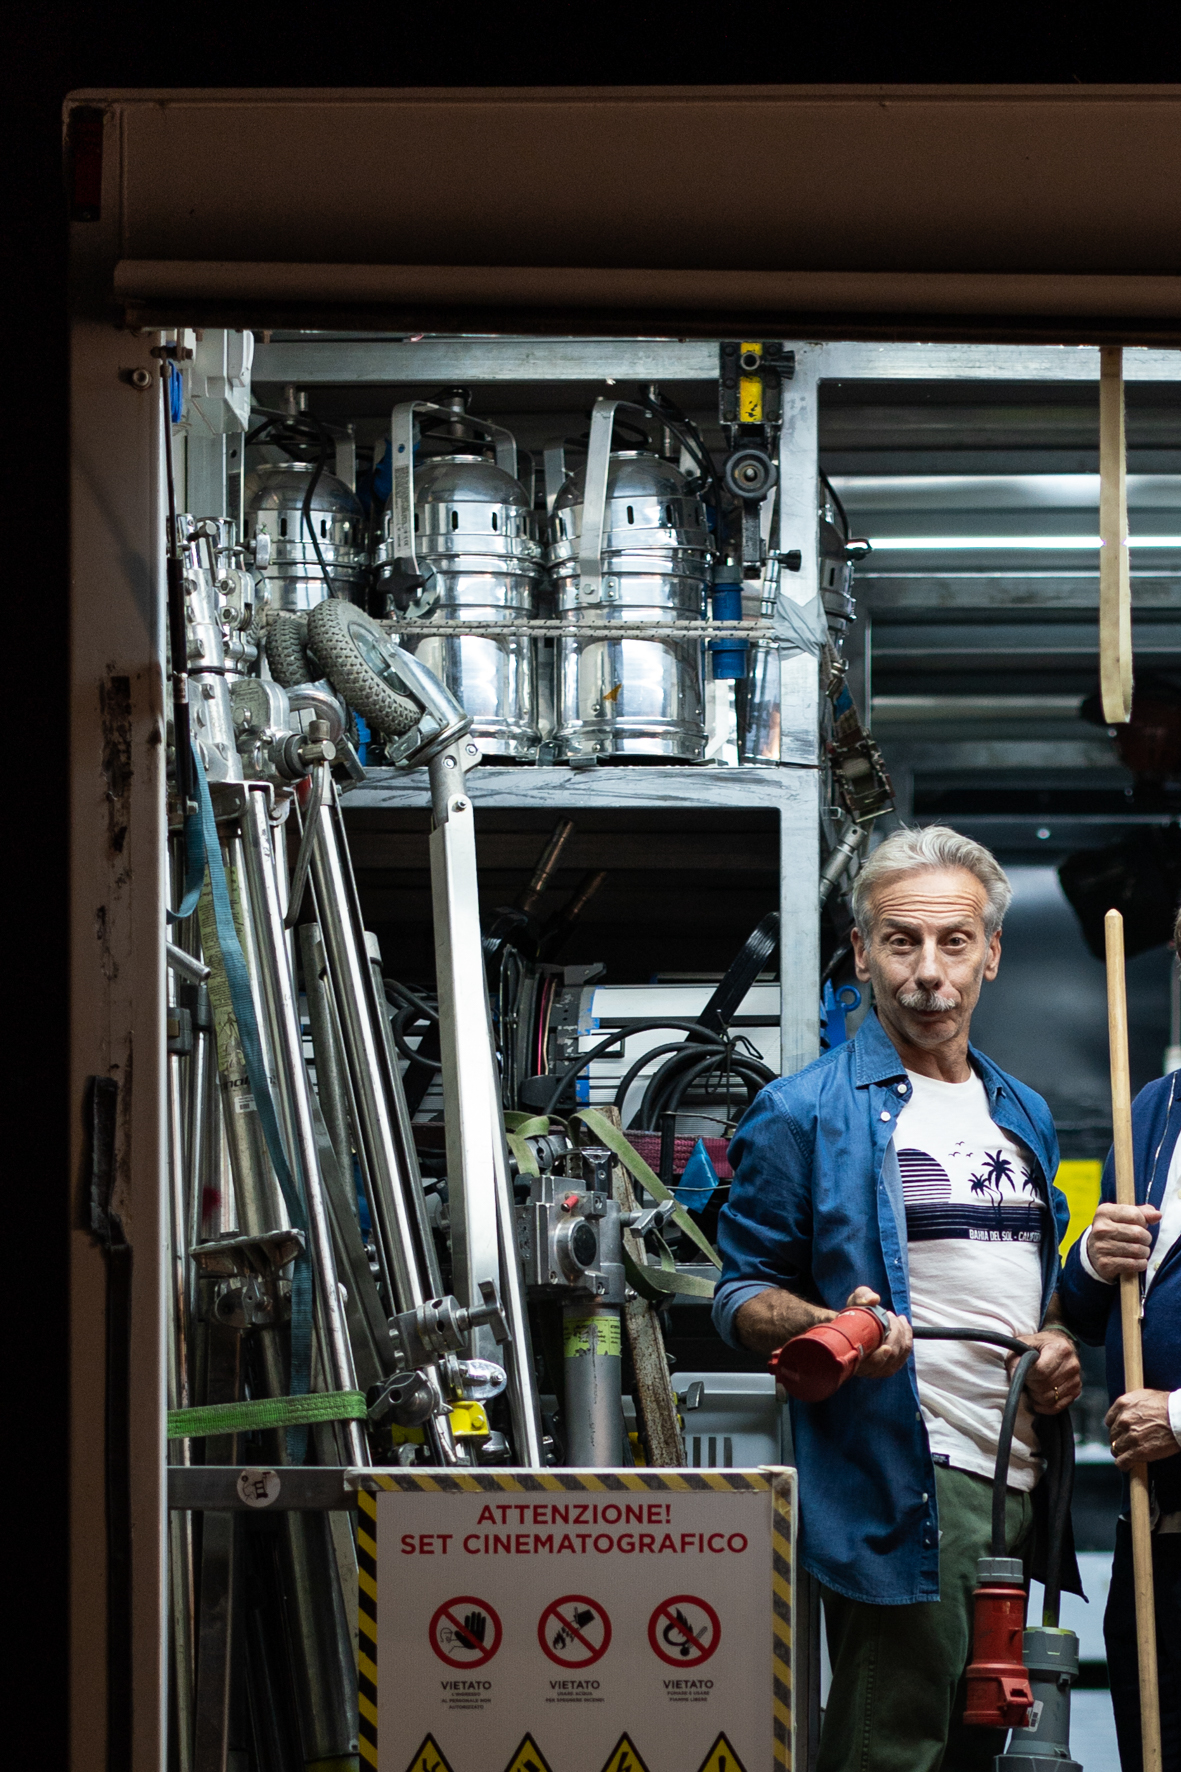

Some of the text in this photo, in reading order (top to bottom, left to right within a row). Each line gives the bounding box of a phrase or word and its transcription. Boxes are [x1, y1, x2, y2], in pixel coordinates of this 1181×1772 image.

[969, 1229, 989, 1241] BAHIA
[989, 1230, 1001, 1241] DEL
[1002, 1231, 1013, 1241] SOL
[476, 1503, 672, 1526] ATTENZIONE!
[400, 1532, 749, 1556] SET CINEMATOGRAFICO
[440, 1680, 492, 1691] VIETATO
[549, 1680, 601, 1690] VIETATO
[663, 1679, 714, 1690] VIETATO
